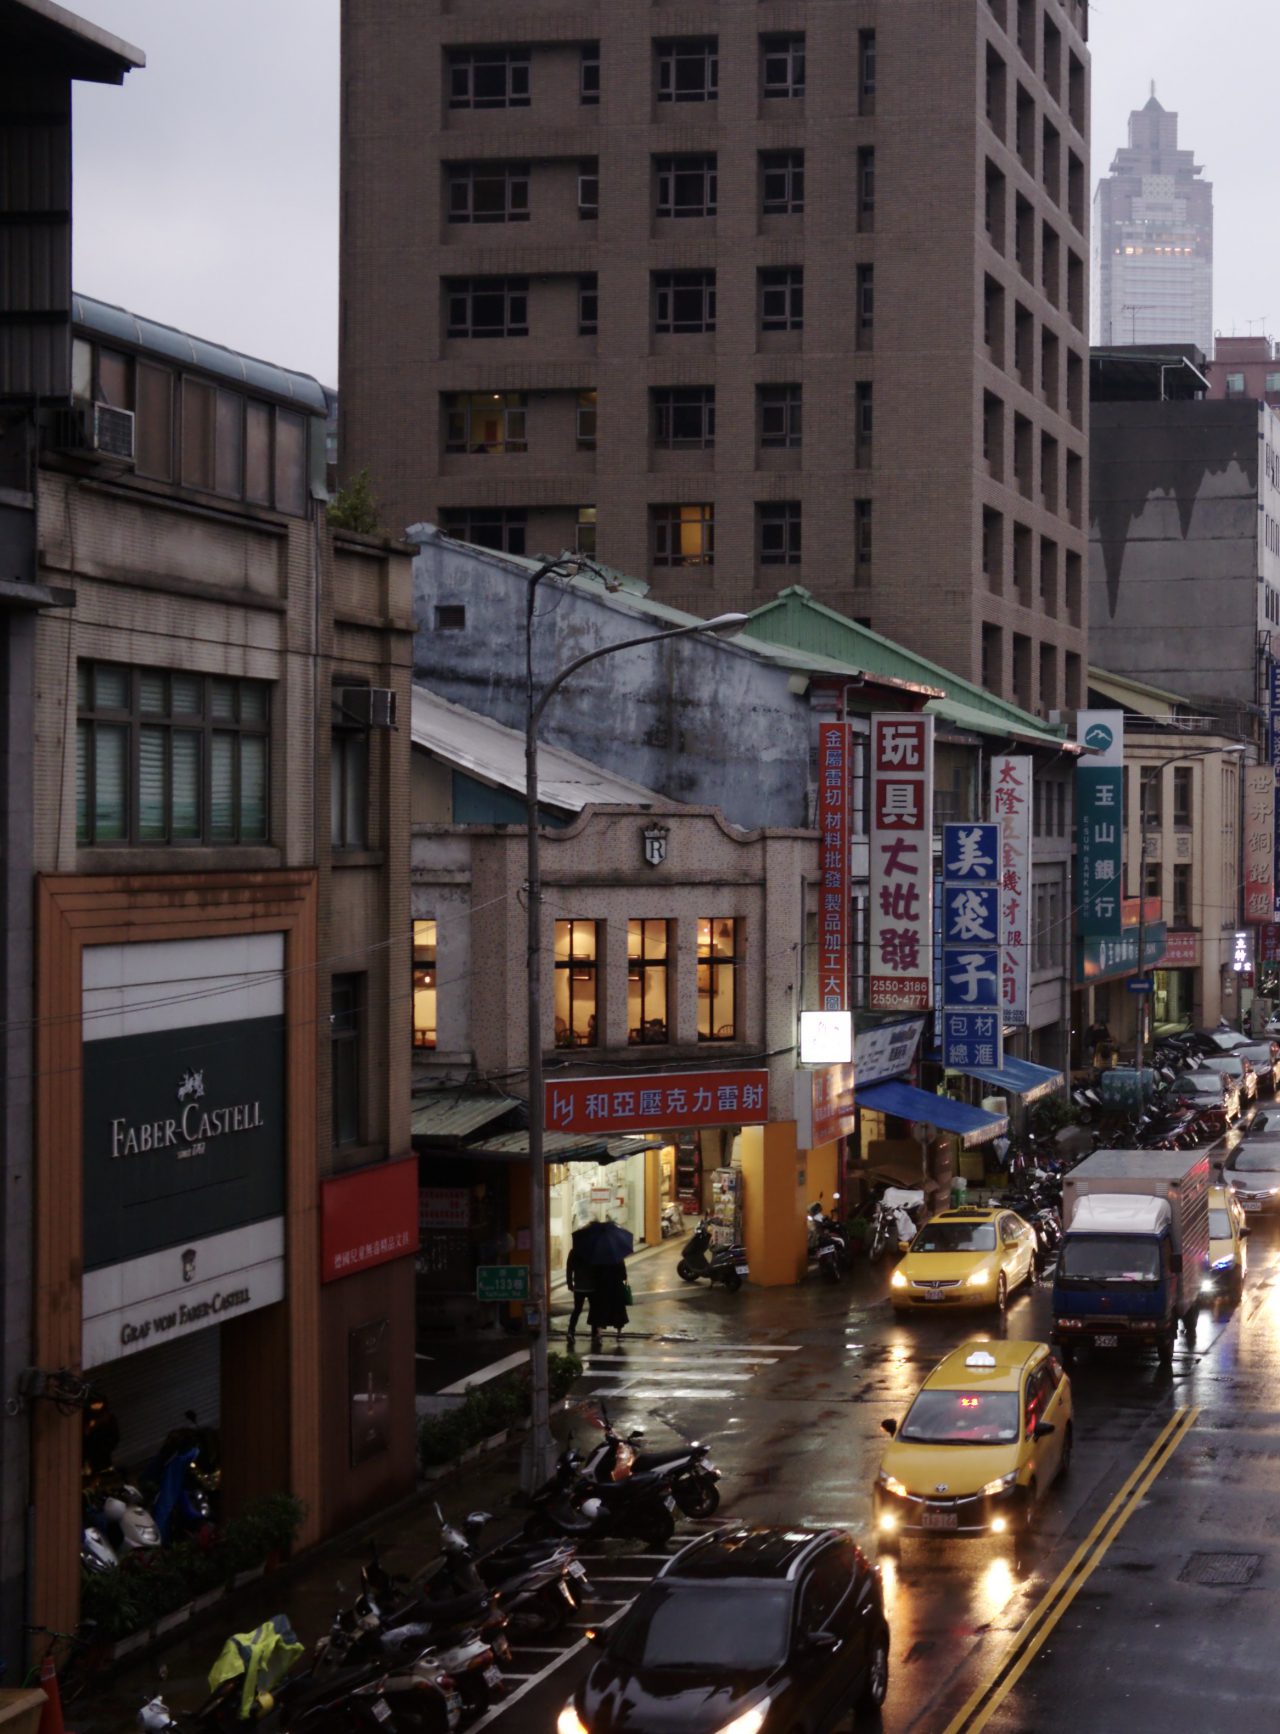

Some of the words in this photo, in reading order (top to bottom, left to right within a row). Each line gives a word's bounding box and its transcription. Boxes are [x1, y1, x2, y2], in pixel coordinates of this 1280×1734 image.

[650, 839, 663, 858] R
[824, 812, 842, 888] 材料批發
[879, 725, 920, 972] 玩具大批發
[1094, 784, 1115, 918] 玉山銀行
[823, 894, 842, 969] 製品加工
[947, 827, 996, 1001] 美袋子
[873, 980, 927, 992] 2550-3186
[873, 994, 927, 1005] 2550-4777
[949, 1016, 994, 1037] 包材
[111, 1101, 264, 1158] FABER-CASTELL
[585, 1083, 764, 1120] 和亞壓克力雷射
